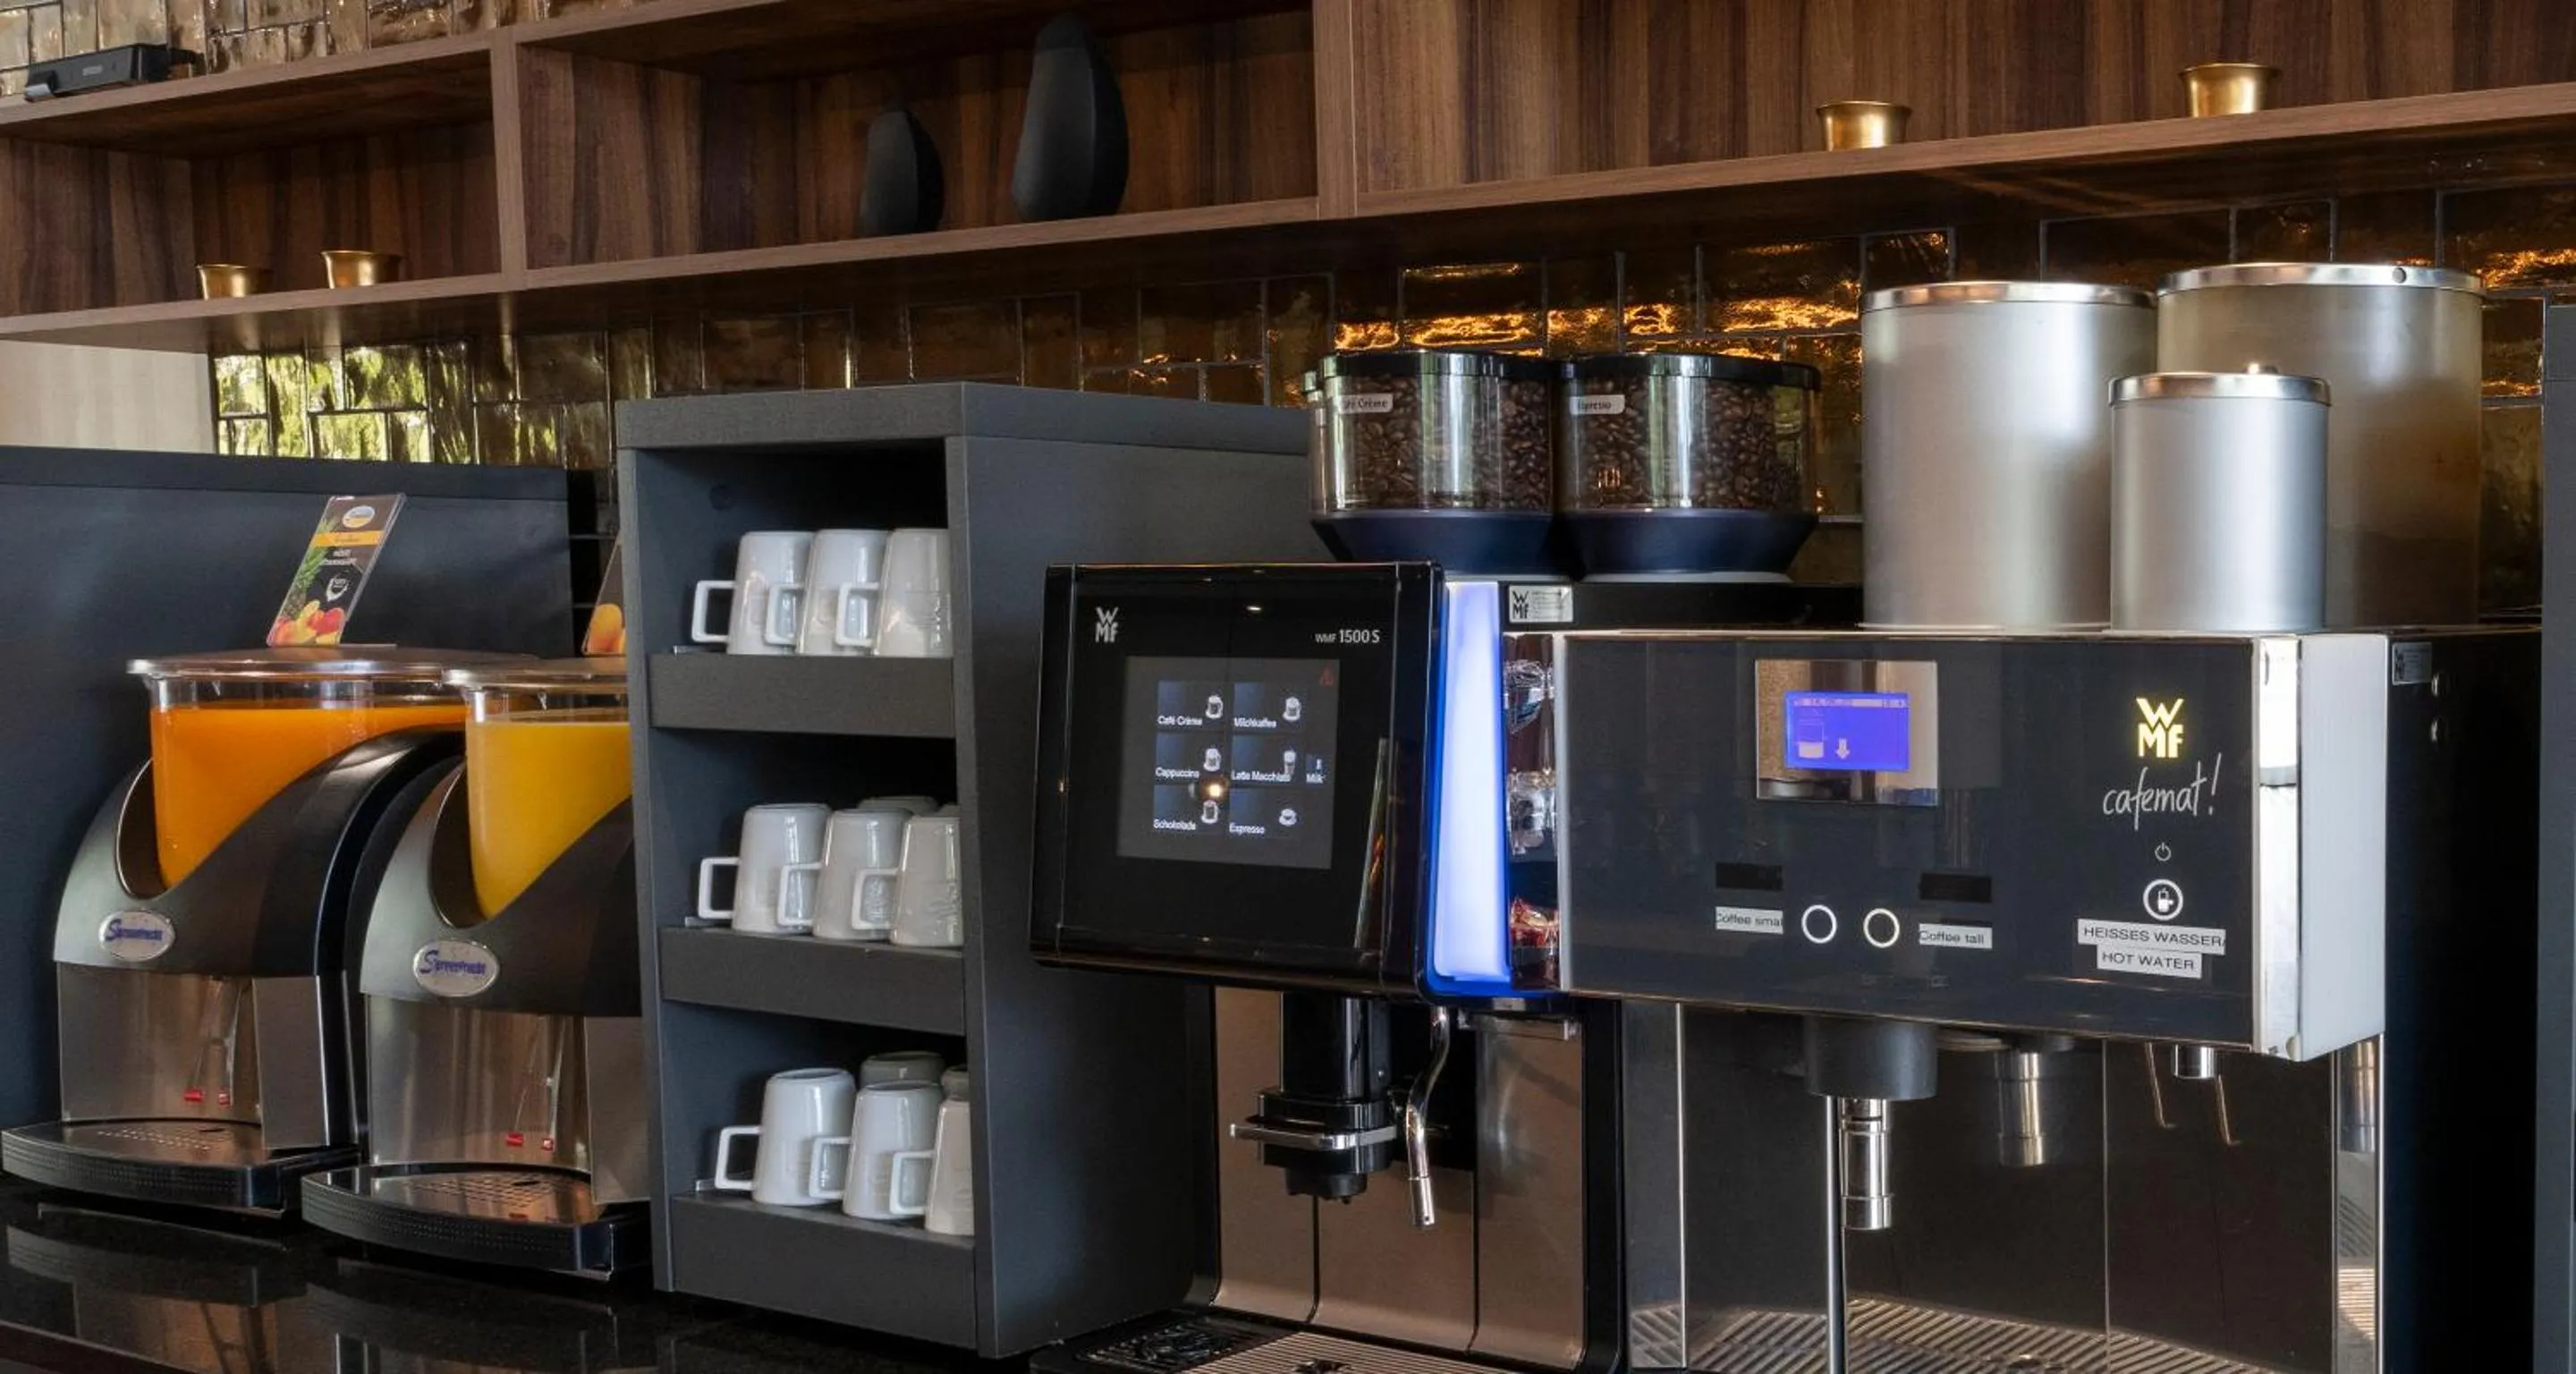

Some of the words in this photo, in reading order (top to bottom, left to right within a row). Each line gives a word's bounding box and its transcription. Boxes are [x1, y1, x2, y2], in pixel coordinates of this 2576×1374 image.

[1339, 629, 1370, 643] 1500
[1371, 629, 1380, 643] S
[1155, 766, 1200, 781] Cappuccino
[2103, 751, 2223, 832] cafemat!
[1153, 819, 1197, 831] Schokolade
[1918, 930, 1961, 942] Coffee
[1965, 933, 1985, 946] tall
[2084, 926, 2149, 942] HEISSES
[2102, 952, 2136, 964] HOT
[2139, 955, 2195, 971] WATER
